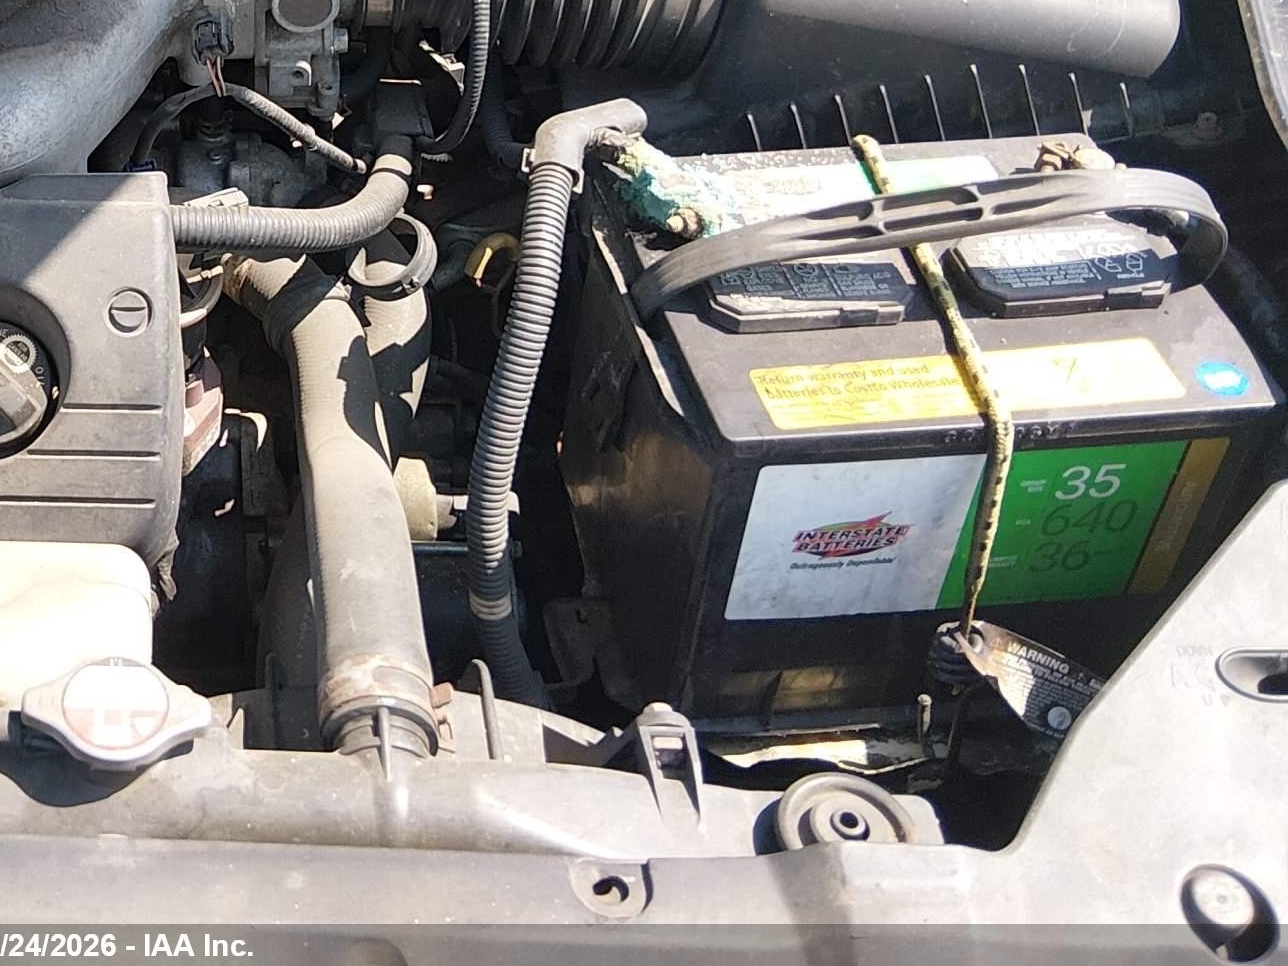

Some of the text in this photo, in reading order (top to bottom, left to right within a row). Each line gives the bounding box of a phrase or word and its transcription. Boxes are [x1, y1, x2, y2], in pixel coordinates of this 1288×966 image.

[870, 365, 895, 378] and
[1054, 463, 1127, 501] 35
[1041, 499, 1139, 536] 640
[795, 525, 908, 541] INTERSTATE
[797, 536, 897, 552] BATTERIES
[1007, 641, 1070, 674] WARNING
